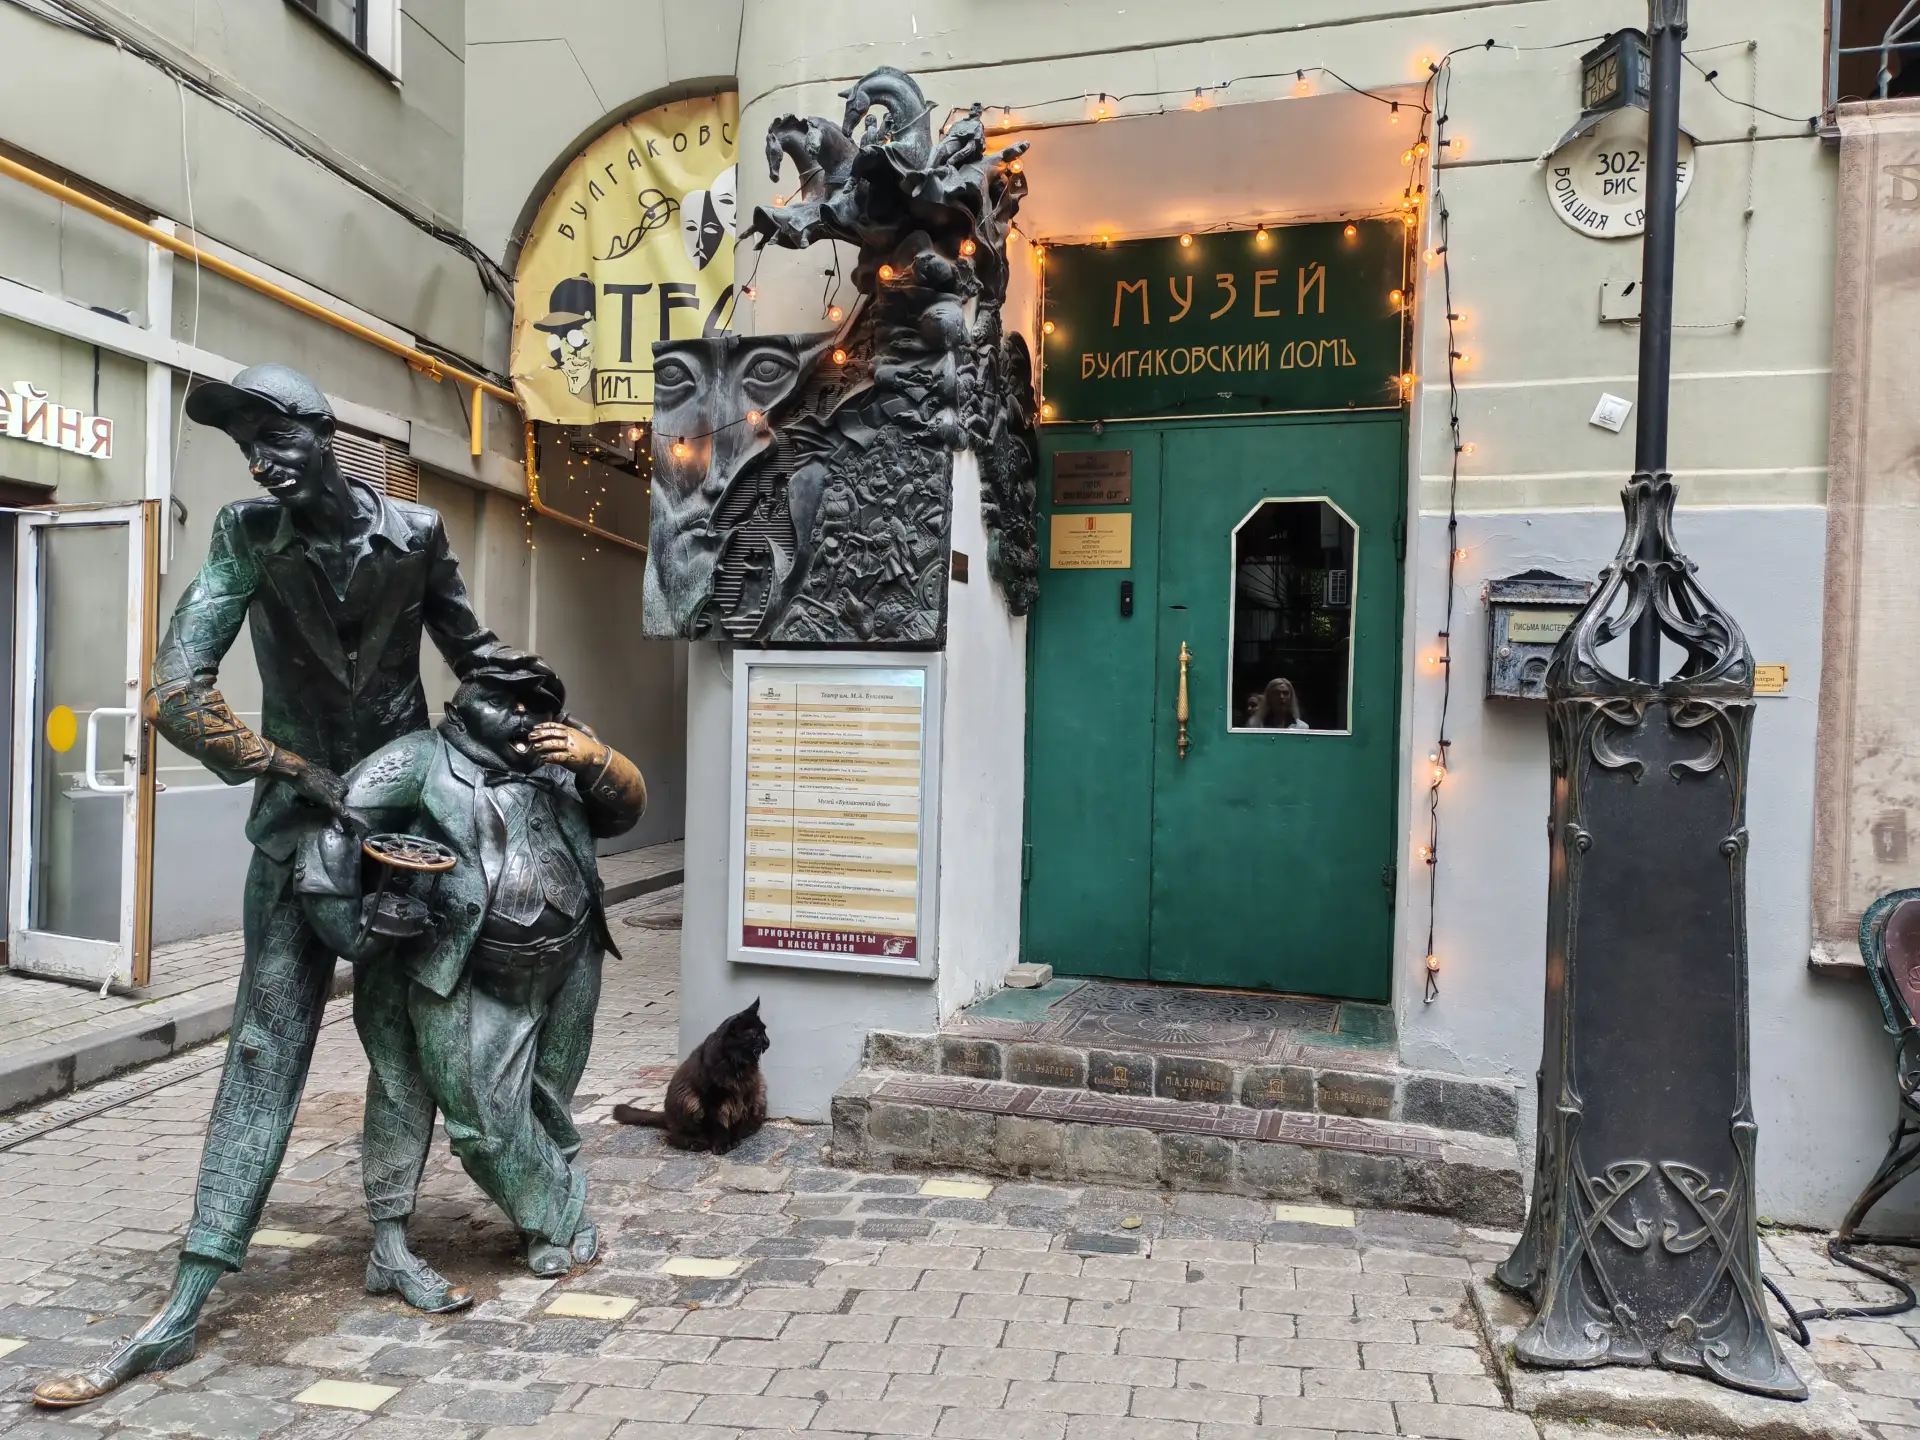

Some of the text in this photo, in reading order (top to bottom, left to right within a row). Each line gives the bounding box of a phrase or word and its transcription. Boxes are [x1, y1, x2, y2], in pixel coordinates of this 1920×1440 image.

[1595, 150, 1646, 176] 302-
[1603, 177, 1638, 196] БИС
[1553, 167, 1610, 231] БОЛЬШАЯ
[1112, 261, 1327, 327] МУЗЕЙ
[1081, 338, 1357, 380] БУЛГАКОВСКИЙ ДОМЪ
[601, 375, 639, 401] ИМ.
[1513, 622, 1569, 632] ПИСЬМА МАСТЕР
[821, 692, 839, 700] Театр
[758, 928, 876, 944] ПРИОБРЕТАЙТЕ БИЛЕТЫ
[778, 940, 855, 952] В КАССЕ МУЗЕЯ
